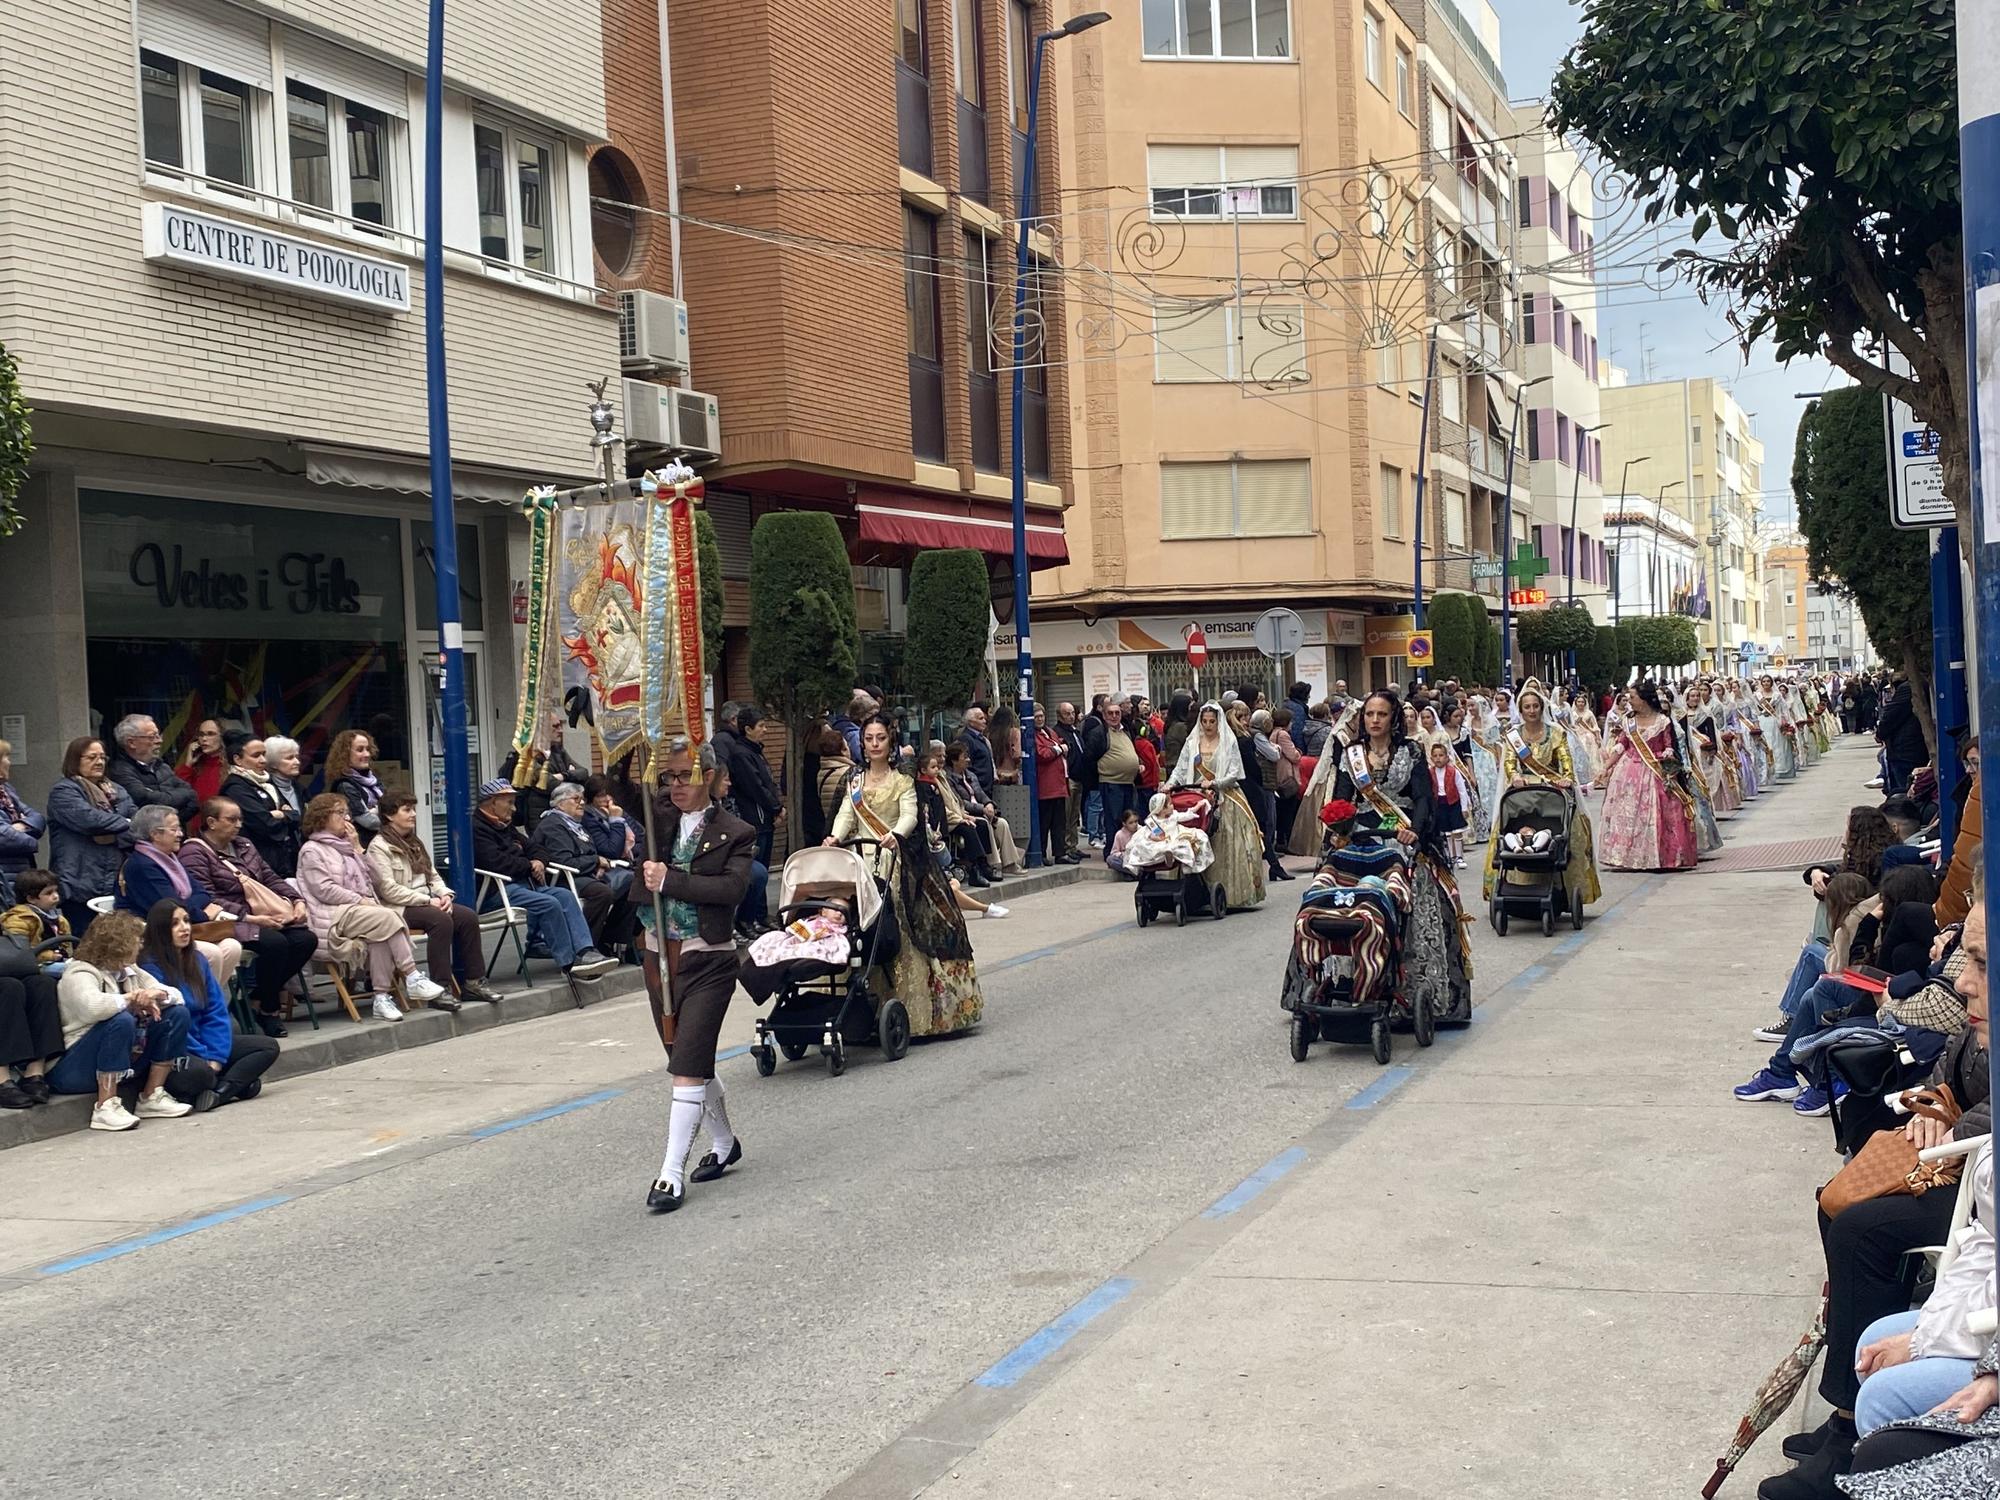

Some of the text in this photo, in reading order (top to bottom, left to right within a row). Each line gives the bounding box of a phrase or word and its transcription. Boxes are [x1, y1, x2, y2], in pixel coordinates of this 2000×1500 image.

[167, 215, 404, 302] CENTRE DE PODOLOGIA
[531, 526, 545, 583] FALLER
[674, 515, 693, 570] PADRINA
[1472, 562, 1503, 577] FARMAC
[129, 542, 361, 614] Vetes i Fils
[679, 574, 692, 592] DE
[530, 588, 542, 643] MAJOR
[1204, 620, 1256, 634] emsane
